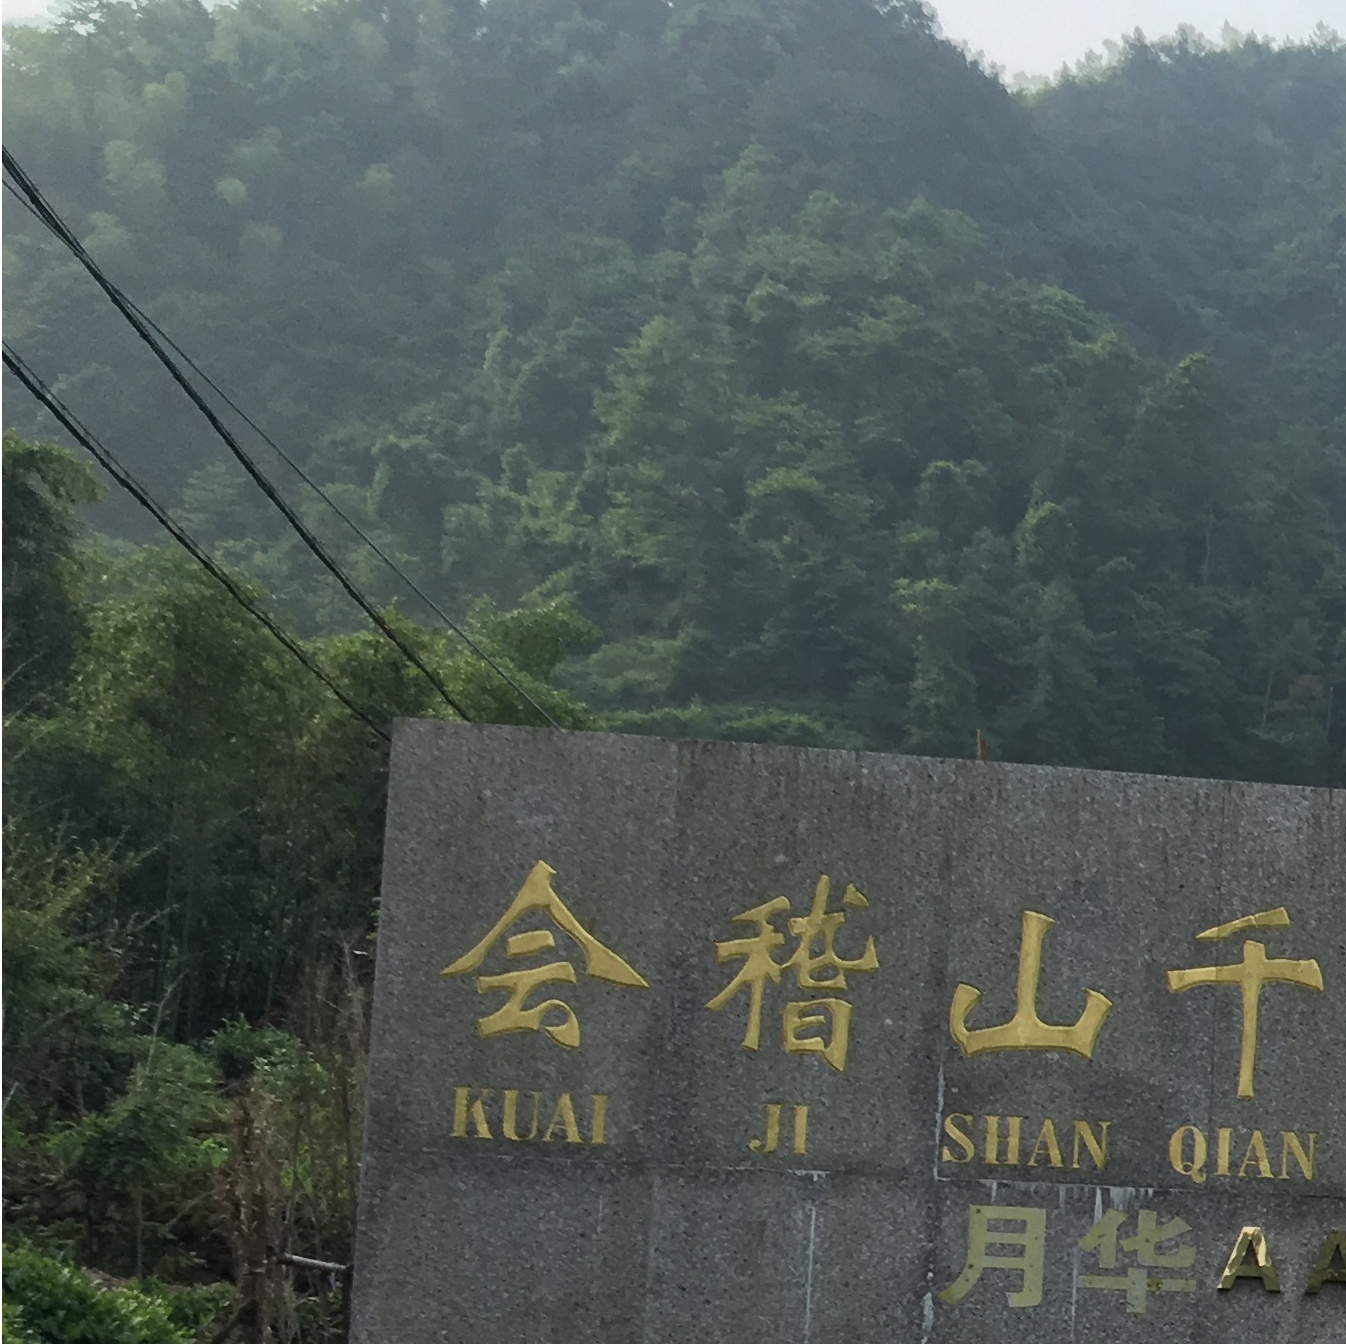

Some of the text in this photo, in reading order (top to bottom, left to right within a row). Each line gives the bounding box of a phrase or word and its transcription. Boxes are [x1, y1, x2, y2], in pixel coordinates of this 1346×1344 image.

[449, 1087, 604, 1145] KUAI
[749, 1104, 811, 1157] JI
[941, 1113, 1112, 1172] SHAN
[1168, 1124, 1319, 1183] QIAN
